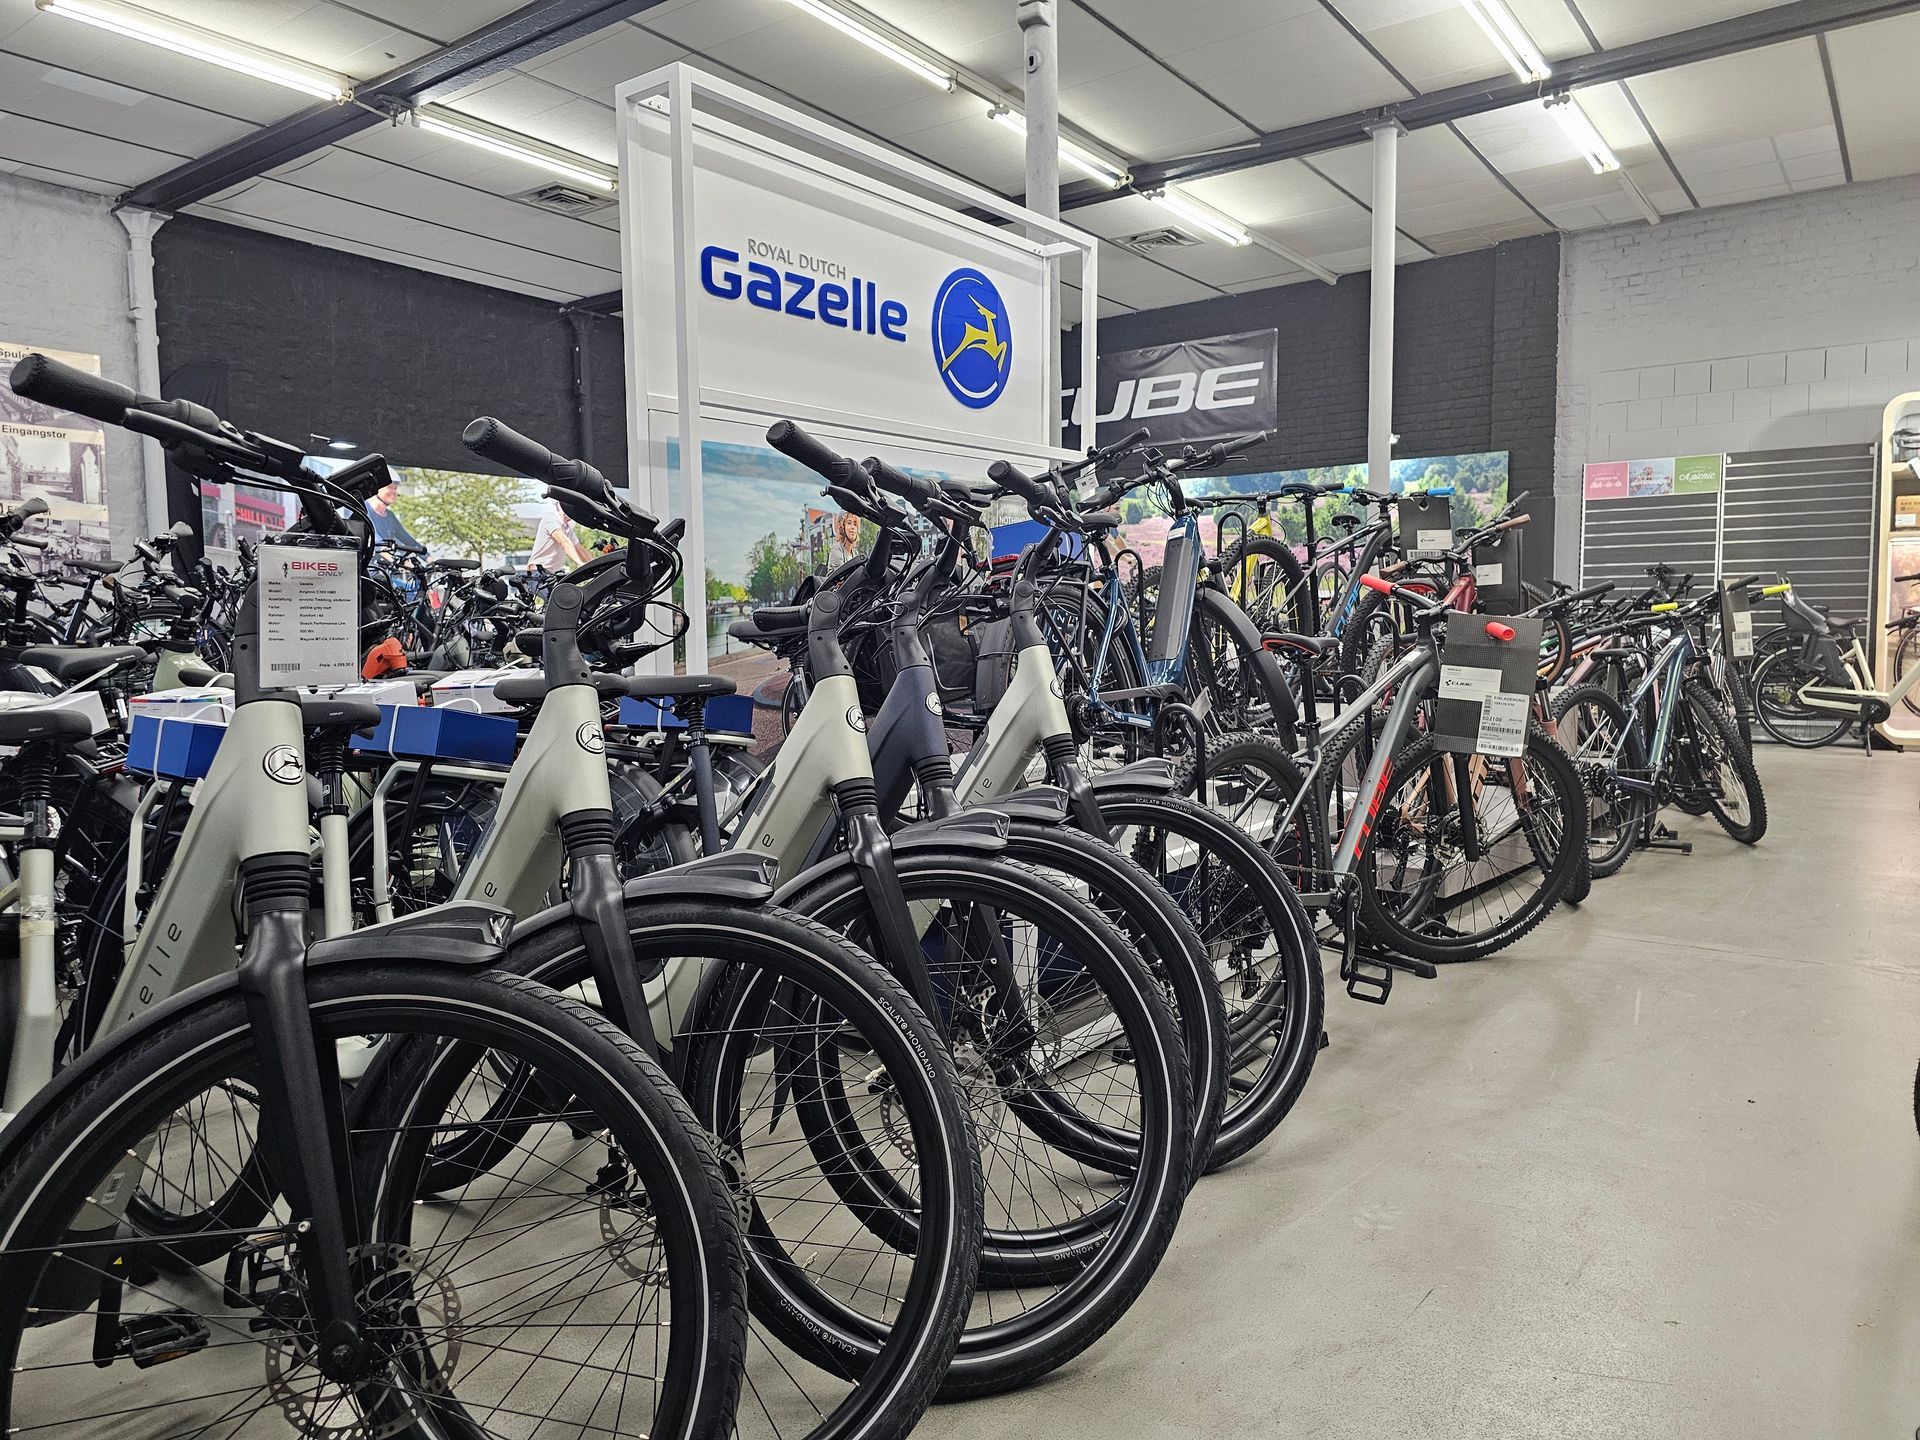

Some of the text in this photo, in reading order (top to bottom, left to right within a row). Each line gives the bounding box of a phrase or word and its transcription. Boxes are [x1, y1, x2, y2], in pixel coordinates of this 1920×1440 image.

[747, 238, 846, 281] ROYAL DUTCH
[701, 245, 908, 342] Gazelle
[1, 424, 67, 439] Eingangstor
[291, 561, 338, 571] BIKES
[1160, 801, 1192, 814] MONDANO
[877, 996, 936, 1079] SCALATO MONDANO
[821, 1332, 858, 1356] SCALATO
